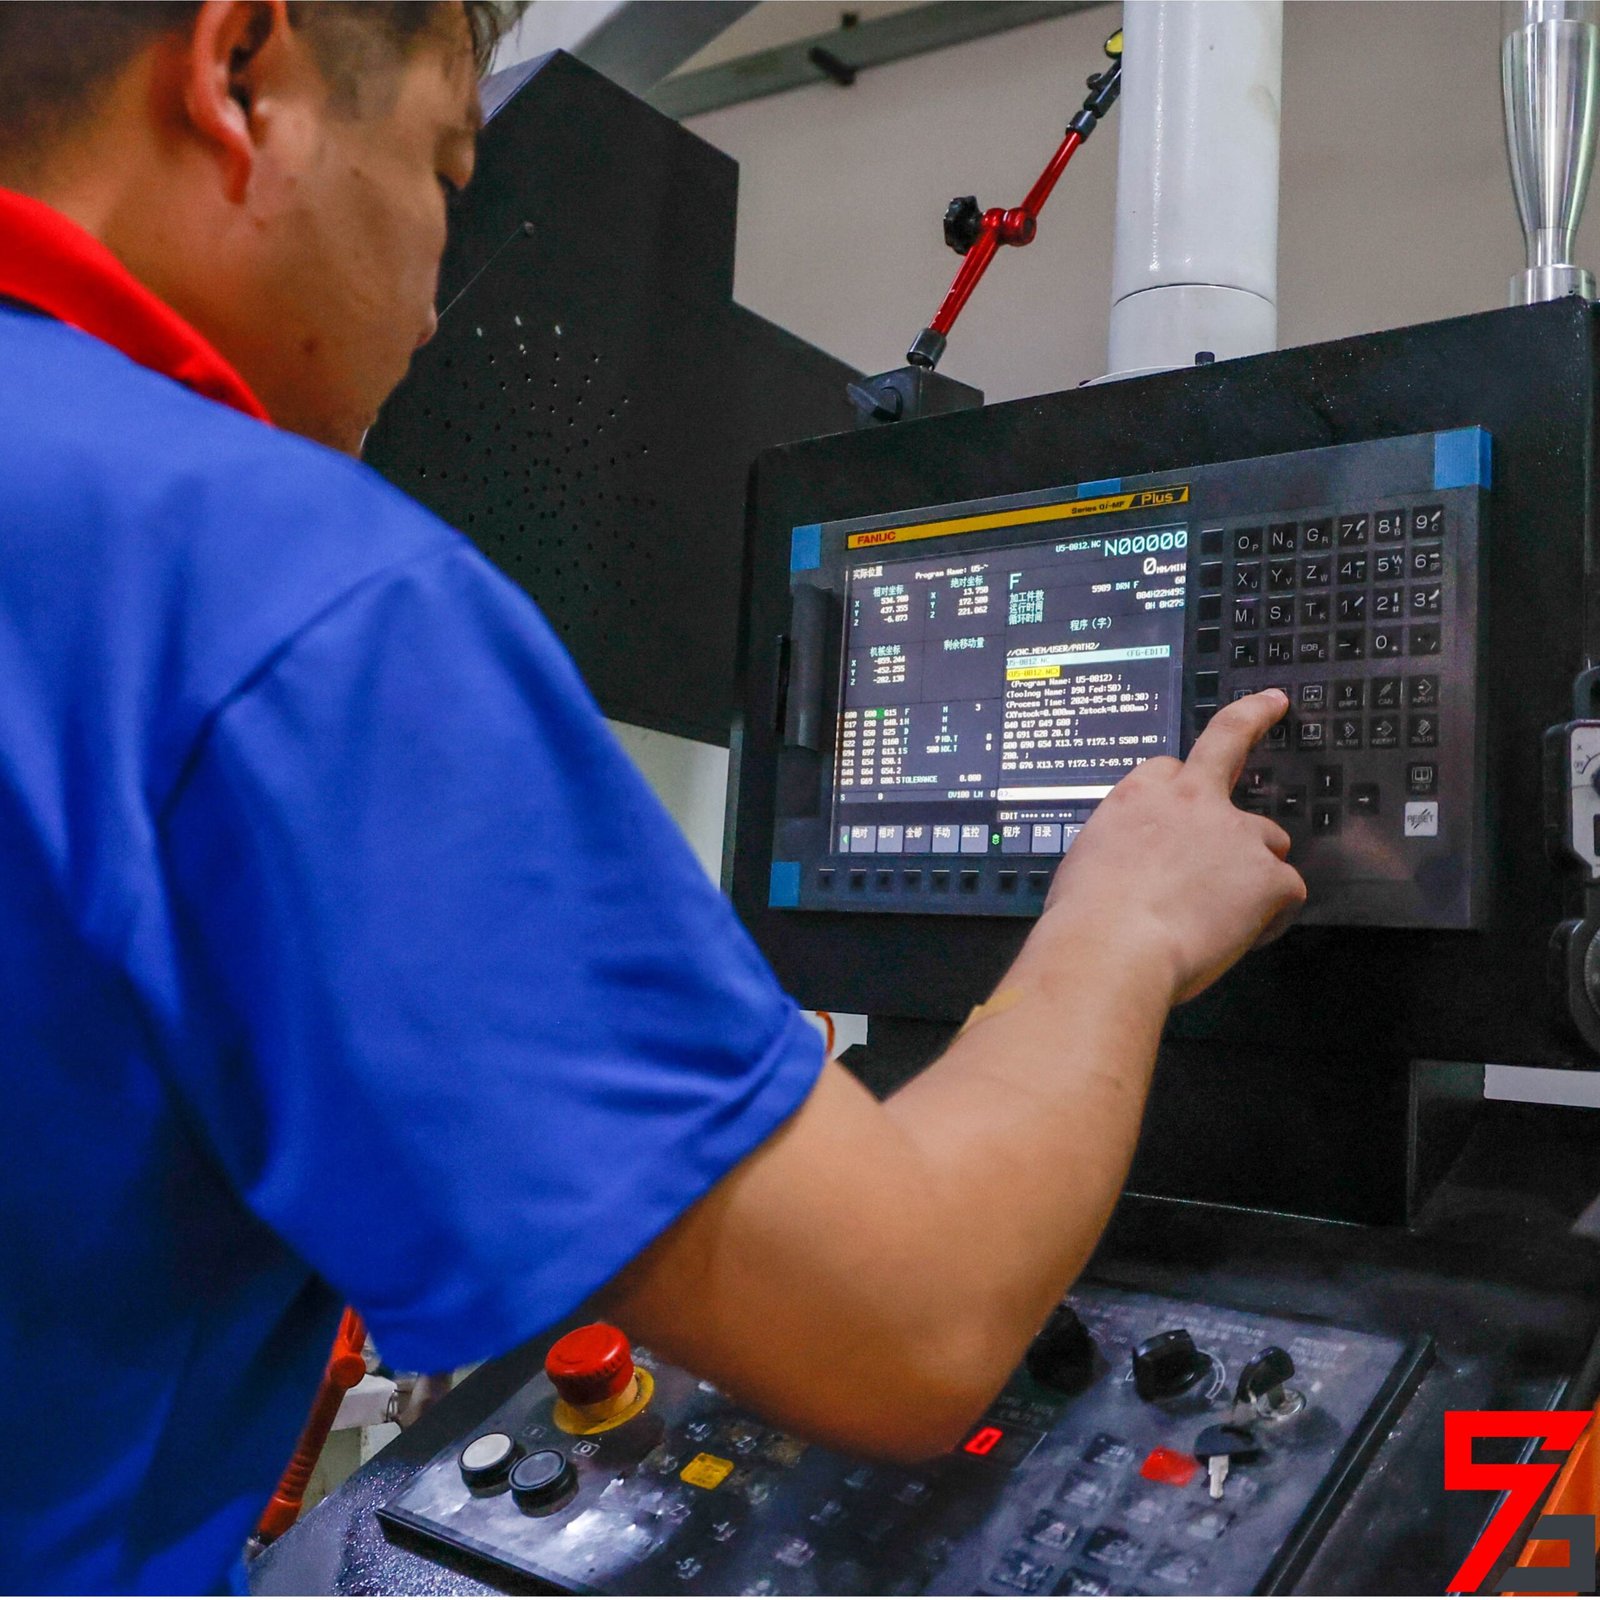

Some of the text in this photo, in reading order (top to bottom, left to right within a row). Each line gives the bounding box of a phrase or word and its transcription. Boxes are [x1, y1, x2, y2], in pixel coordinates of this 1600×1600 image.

[1071, 505, 1097, 515] Series
[1141, 492, 1174, 506] Plus
[1378, 519, 1390, 533] 8
[1416, 515, 1428, 529] 9
[1306, 528, 1319, 542] G
[1342, 523, 1353, 538] 7
[857, 531, 896, 545] FANUC
[1104, 530, 1187, 557] N00000
[1272, 531, 1284, 546] N
[1377, 557, 1389, 572] 5
[1415, 554, 1427, 568] 6
[852, 565, 883, 581] 实际位置
[915, 567, 967, 580] Program Name:
[1306, 565, 1317, 579] Z
[1341, 562, 1352, 575] 4
[950, 575, 984, 588] 绝对坐标
[1009, 572, 1022, 590] F
[1237, 572, 1248, 586] X
[1271, 569, 1282, 583] Y
[873, 584, 904, 598] 相对坐标
[1115, 582, 1130, 590] DRN
[1133, 580, 1140, 589] F
[1009, 589, 1044, 602] 加工件数
[1414, 593, 1426, 607] 3
[854, 600, 860, 608] X
[1306, 603, 1317, 616] T
[1341, 601, 1348, 614] 1
[1377, 596, 1388, 611] 2
[1235, 609, 1247, 623] M
[1270, 607, 1281, 620] S
[853, 619, 859, 627] Z
[943, 636, 984, 651] 剩余移动量
[1269, 643, 1280, 657] H
[870, 644, 901, 657] 机械坐标
[1235, 646, 1245, 659] F
[851, 659, 857, 667] X
[850, 678, 856, 686] Z
[1011, 680, 1046, 688] (Program
[904, 708, 910, 716] F
[975, 703, 981, 711] 3
[1006, 698, 1066, 709] (Process Time:
[1021, 720, 1035, 728] G17
[904, 727, 909, 735] D
[1016, 730, 1030, 738] G91
[903, 737, 908, 745] T
[1055, 738, 1083, 747] X13.75
[1086, 736, 1115, 746] Y172.5
[903, 747, 908, 755] S
[1036, 760, 1064, 769] X13.75
[1067, 758, 1096, 767] Y172.5
[902, 775, 938, 784] TOLERANCE
[1000, 811, 1018, 820] EDIT
[1407, 815, 1434, 823] RESET
[905, 826, 923, 838] 全部
[933, 826, 951, 838] 手动
[962, 826, 980, 838] 监控
[1002, 826, 1021, 838] 程序
[1034, 825, 1052, 838] 目录
